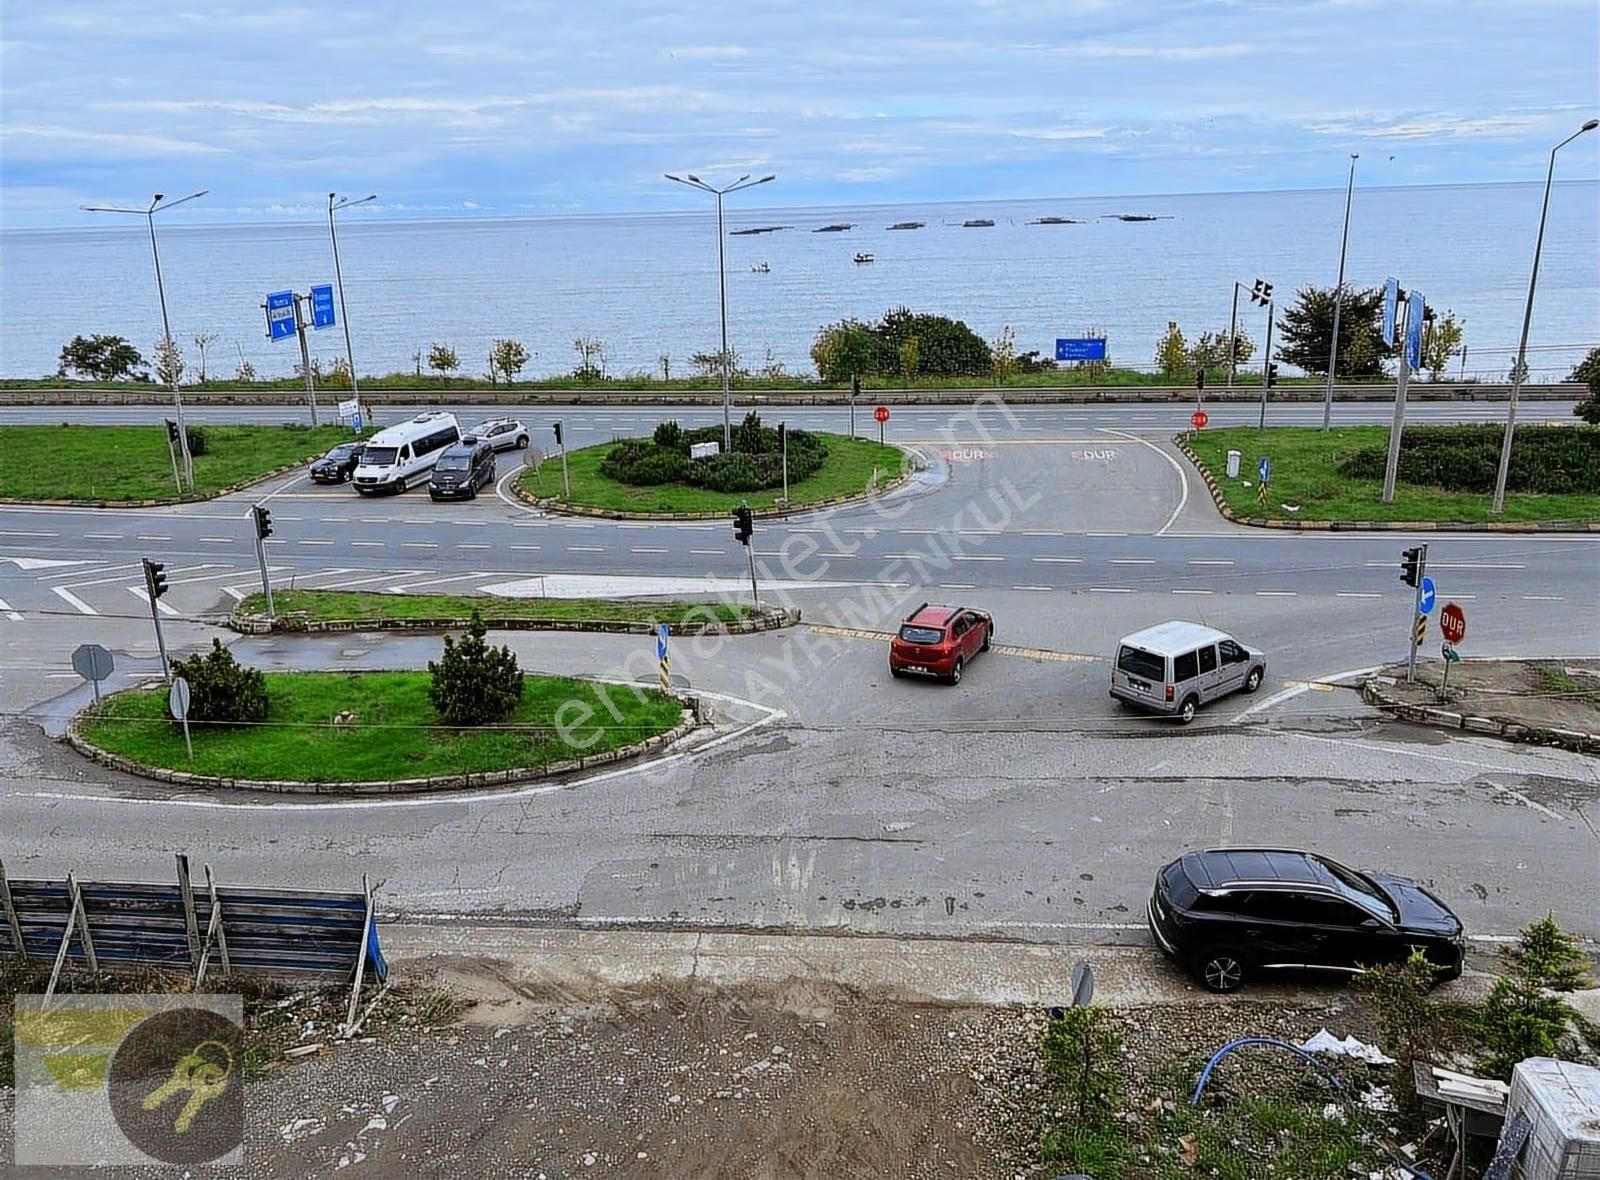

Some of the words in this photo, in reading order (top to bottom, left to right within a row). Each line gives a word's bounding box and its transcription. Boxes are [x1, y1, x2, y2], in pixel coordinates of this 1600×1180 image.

[952, 449, 984, 460] DUR
[1083, 449, 1116, 462] DUR
[1442, 612, 1463, 636] DUR
